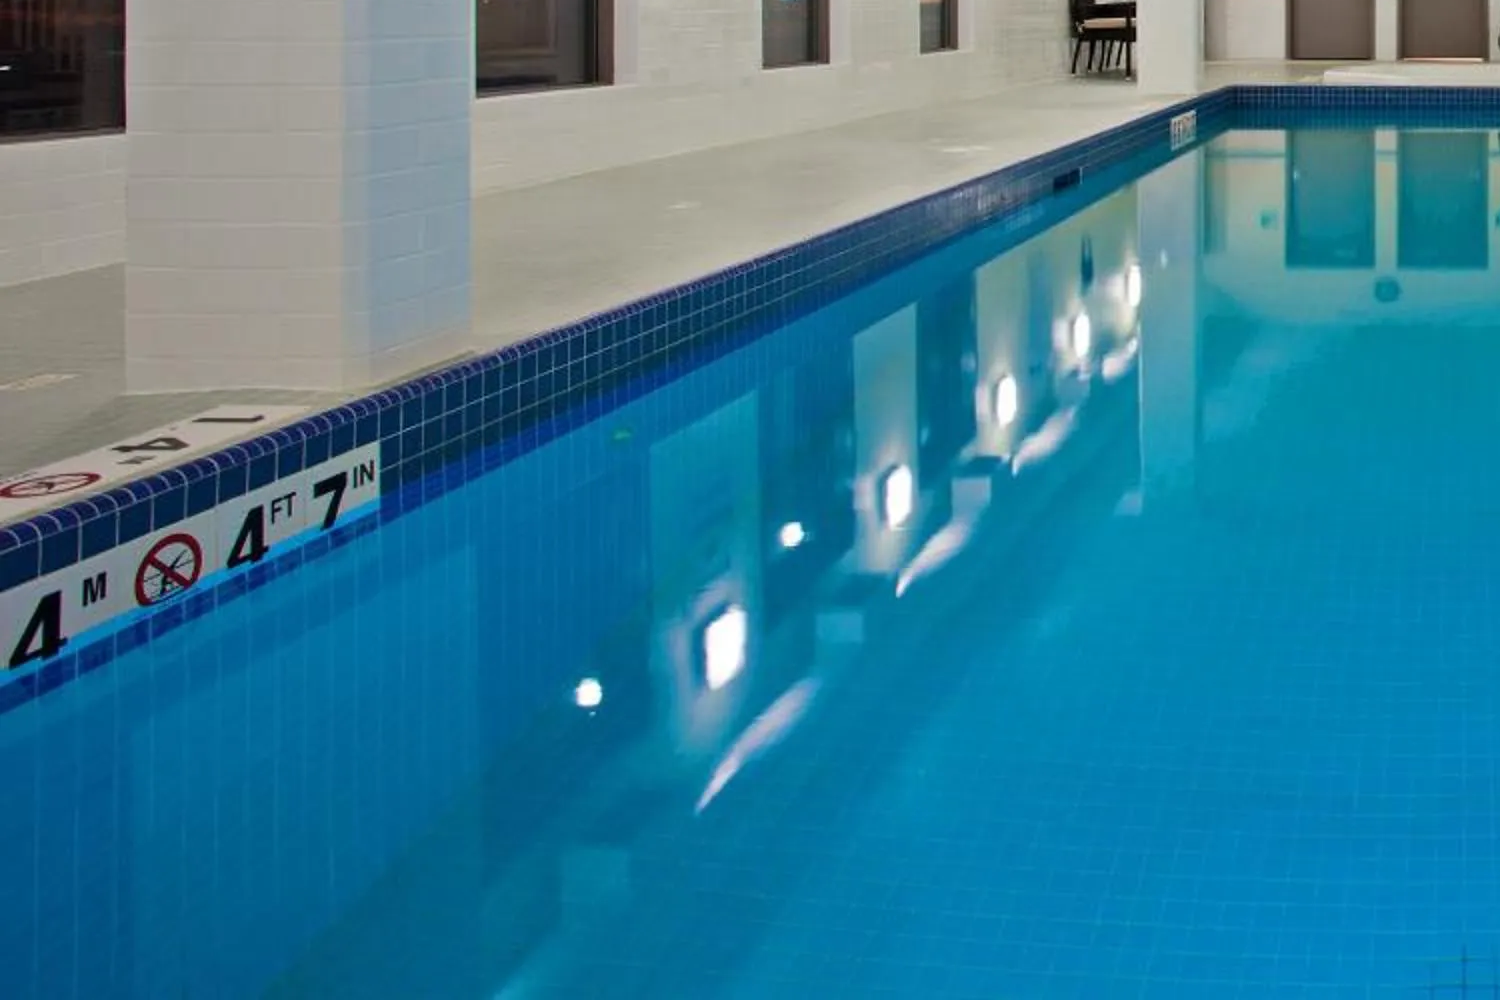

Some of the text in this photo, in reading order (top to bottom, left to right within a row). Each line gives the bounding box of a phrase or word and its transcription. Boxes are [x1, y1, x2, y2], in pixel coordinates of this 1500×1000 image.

[9, 459, 375, 671] 4 M 4 FT 7 IN
